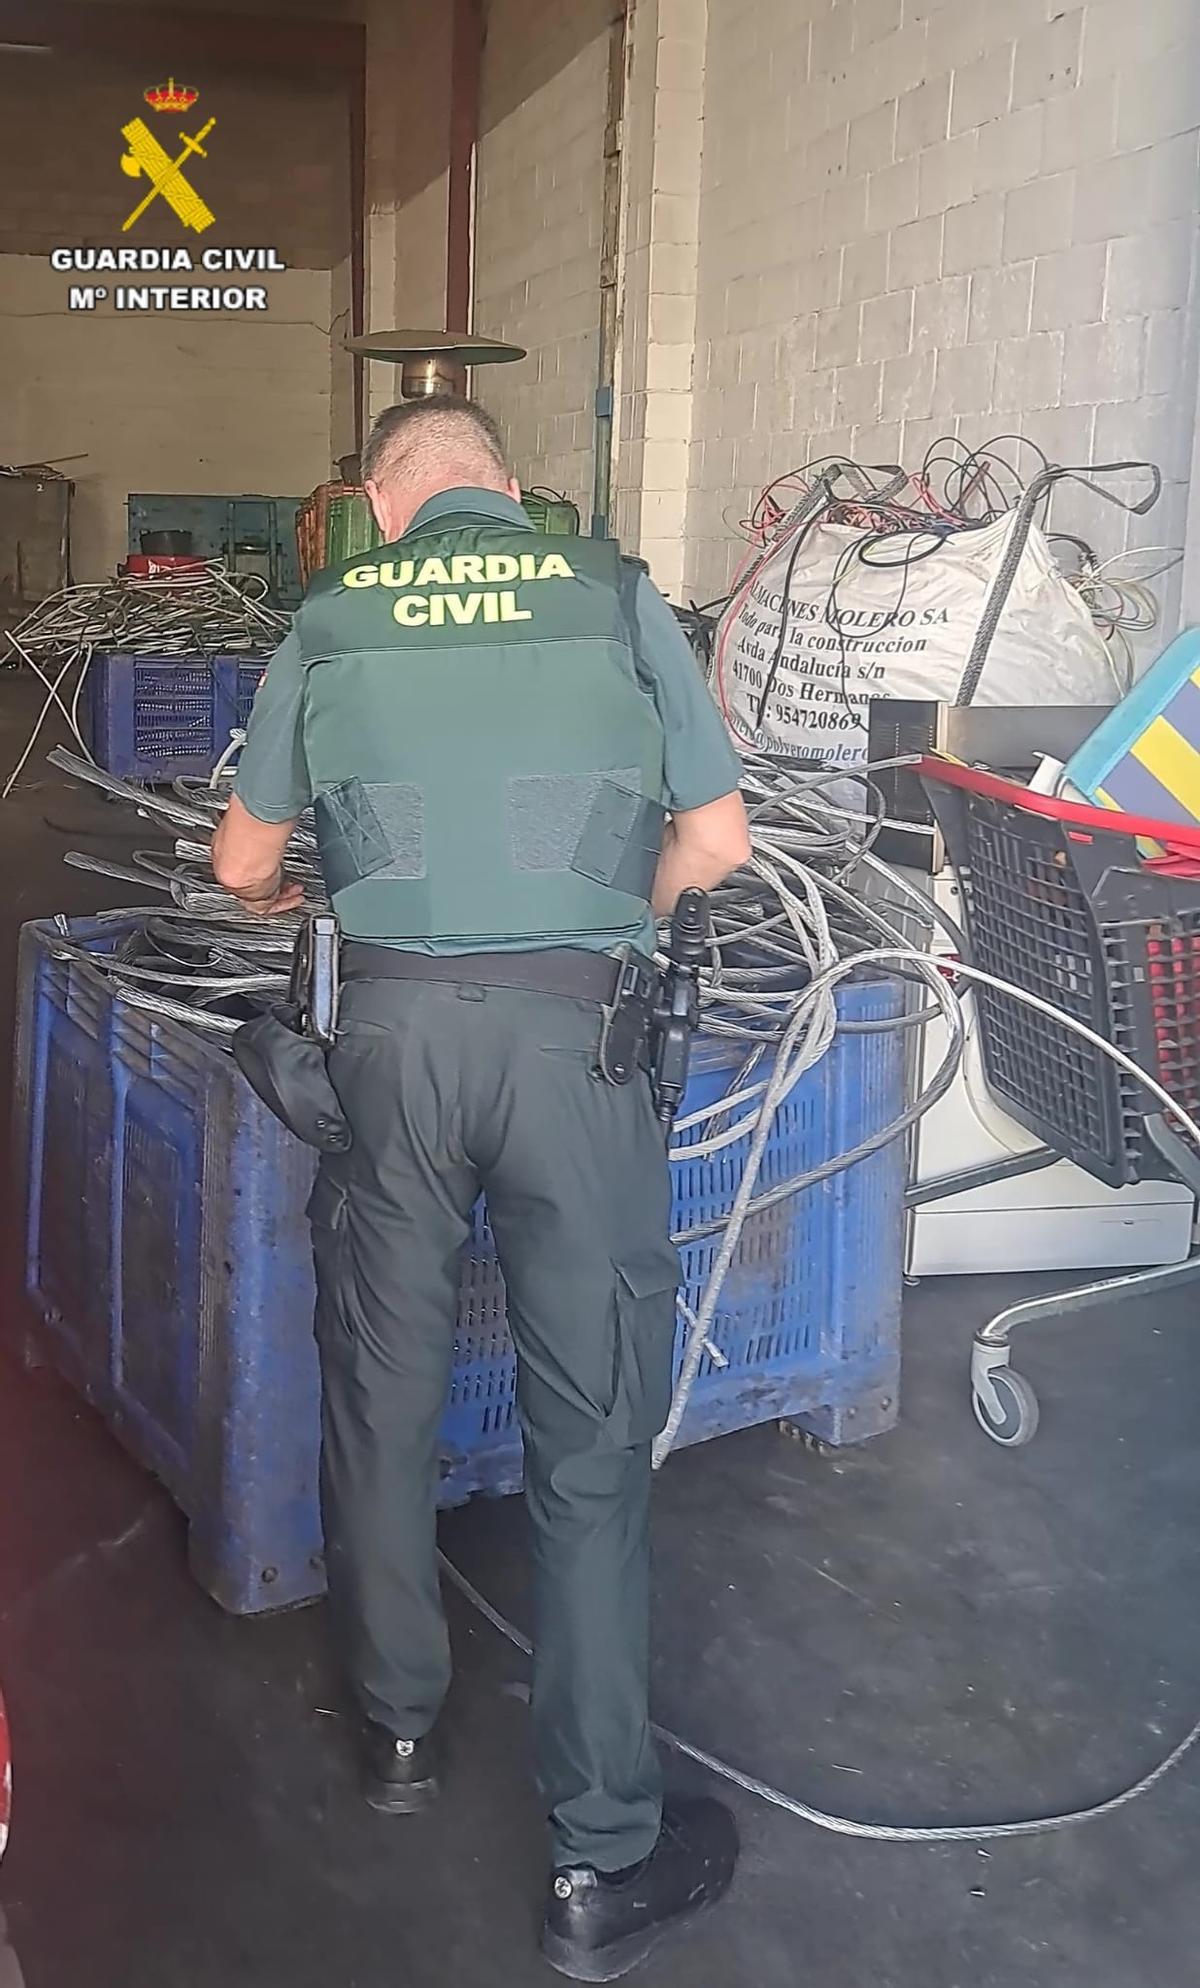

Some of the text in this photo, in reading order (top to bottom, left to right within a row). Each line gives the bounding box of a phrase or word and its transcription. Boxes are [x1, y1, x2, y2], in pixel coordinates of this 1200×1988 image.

[342, 553, 576, 589] GUARDIA
[393, 590, 533, 627] CIVIL
[819, 605, 916, 628] MOLERO
[920, 607, 950, 626] SA
[789, 626, 804, 647] la
[807, 635, 928, 653] construccion
[737, 636, 766, 663] Avda
[857, 661, 886, 680] s/n
[732, 660, 763, 689] 41700
[776, 703, 861, 730] 954720869
